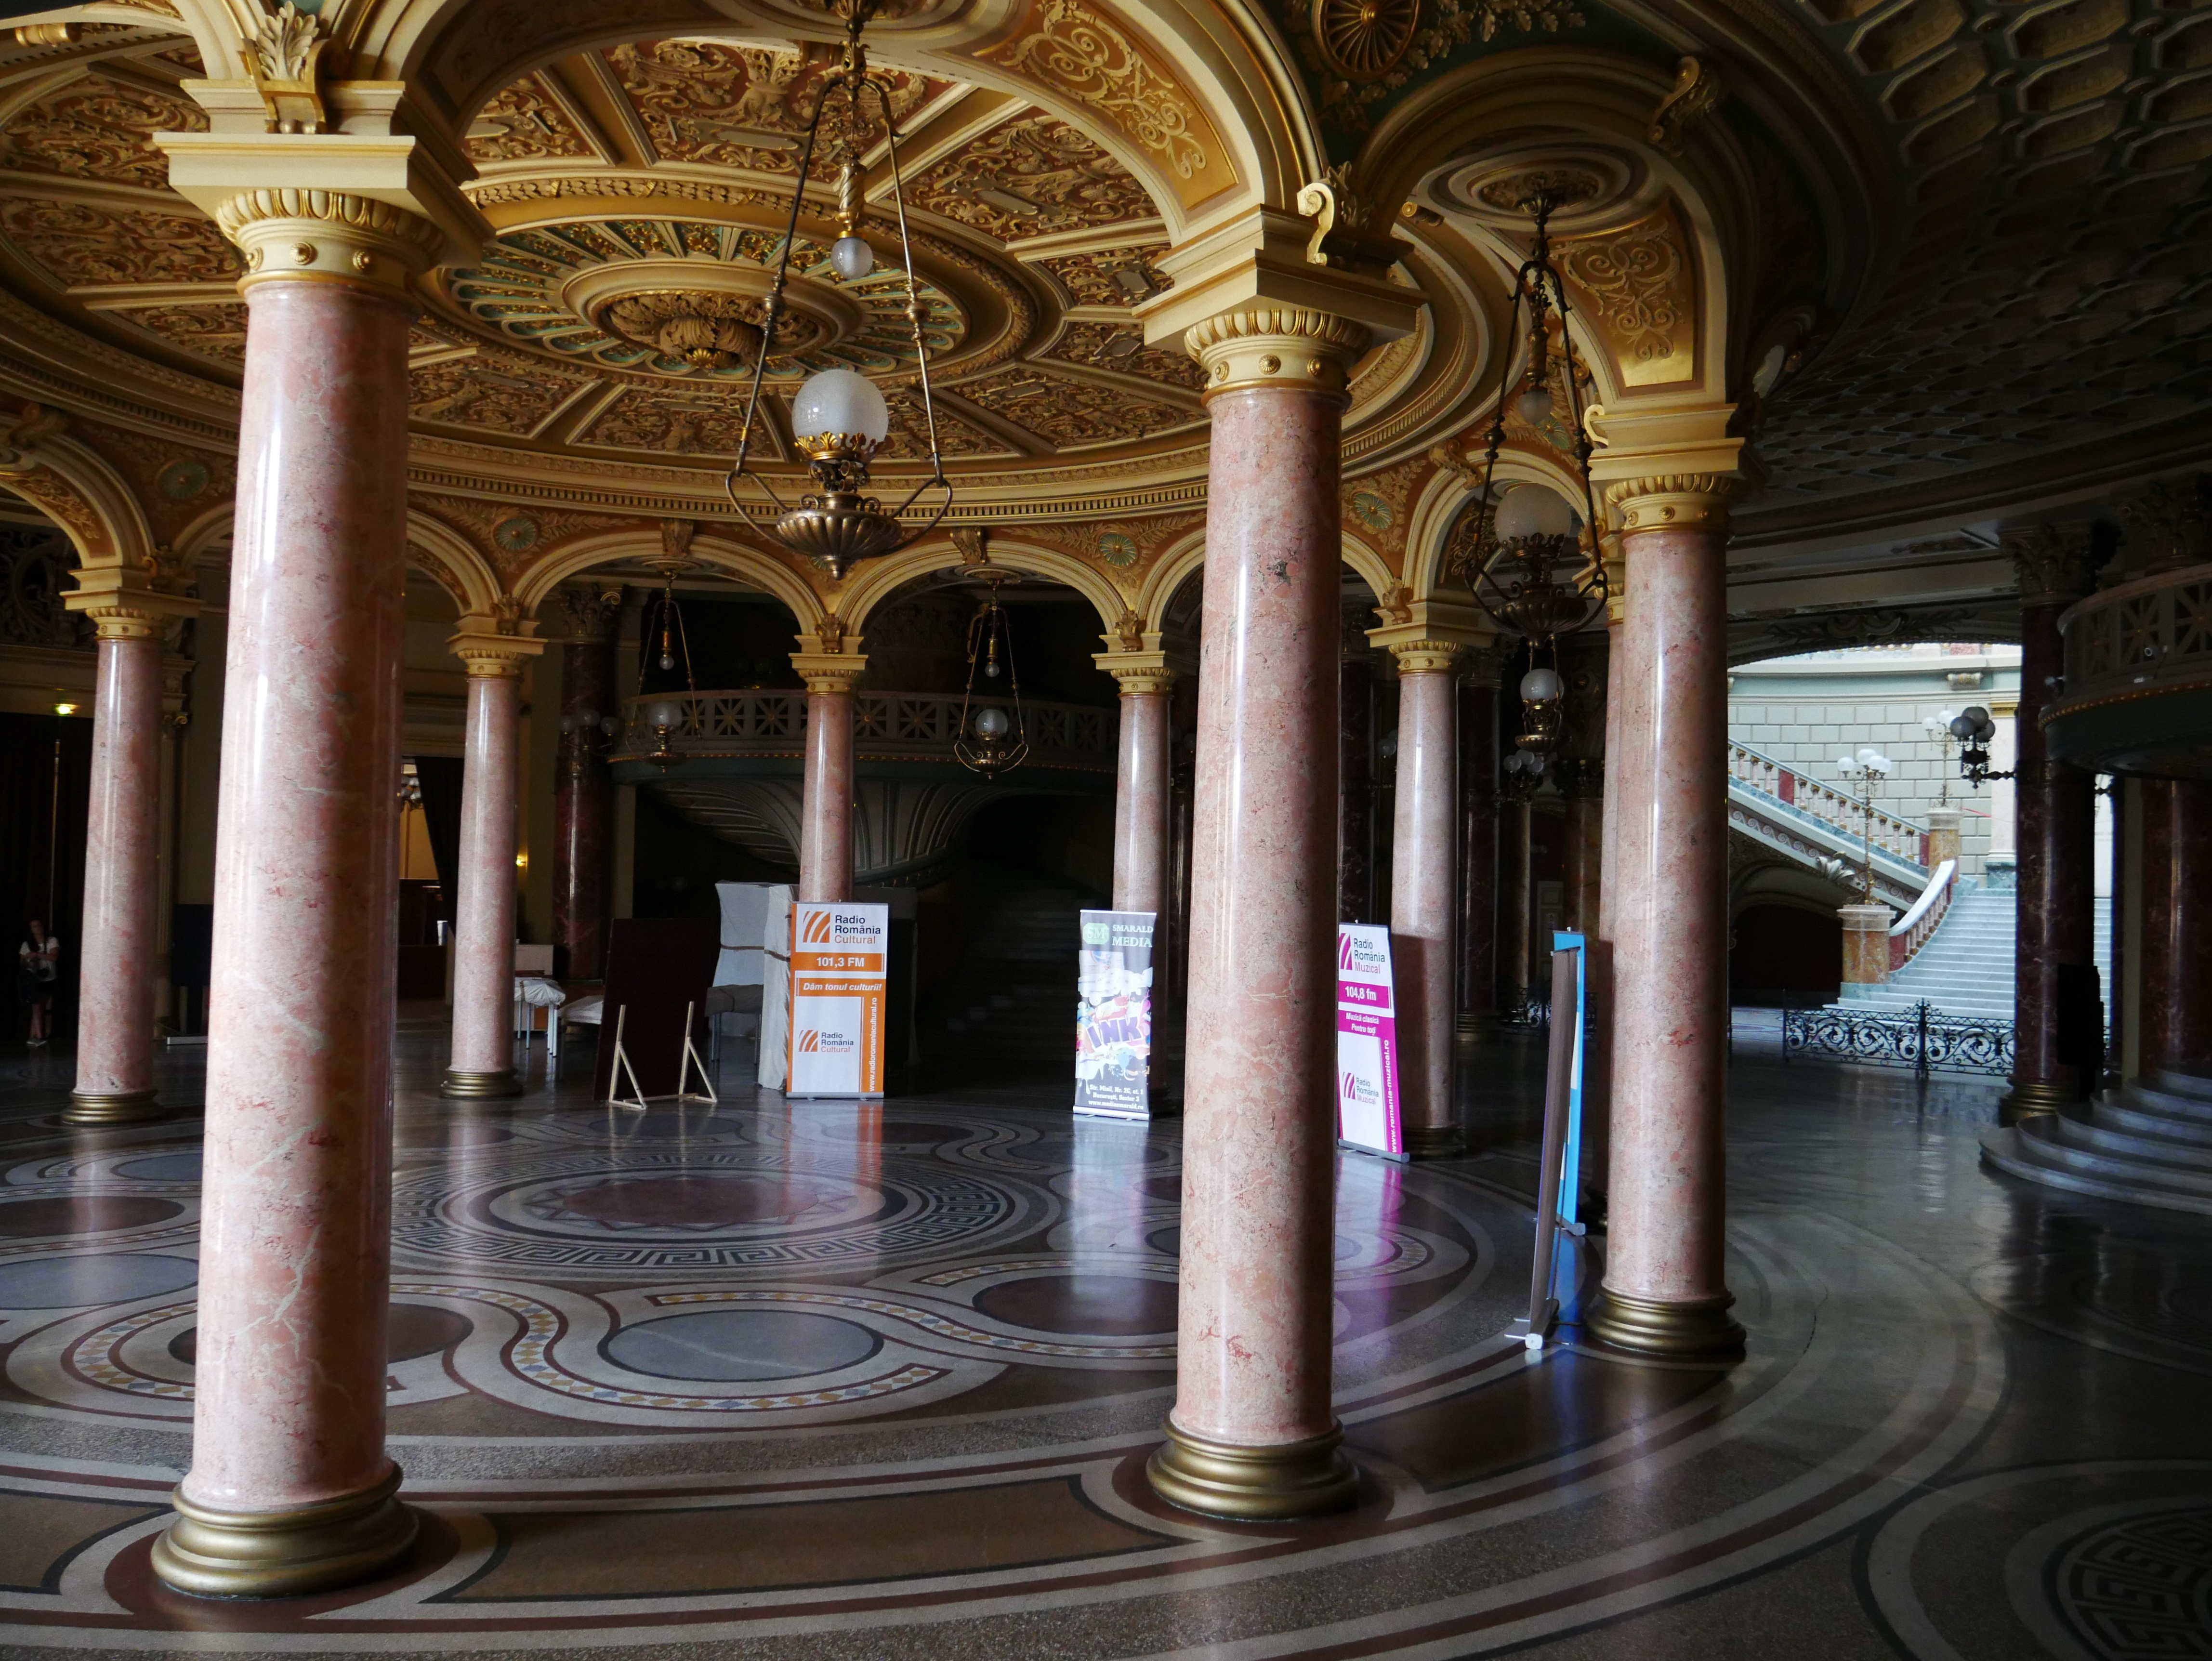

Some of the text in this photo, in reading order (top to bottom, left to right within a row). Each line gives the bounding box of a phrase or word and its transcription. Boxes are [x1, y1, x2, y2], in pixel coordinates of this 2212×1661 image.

[835, 915, 865, 924] Radio
[835, 925, 881, 934] România
[1087, 927, 1105, 939] SM
[1112, 924, 1154, 933] SMARALD
[834, 935, 875, 944] Cultural
[1112, 936, 1152, 948] MEDIA
[1354, 938, 1373, 949] Radio
[1354, 949, 1385, 962] România
[816, 957, 865, 968] 101,3 FM
[1355, 962, 1380, 974] Muzical
[803, 983, 823, 991] Dăm
[849, 983, 882, 991] culturii!
[1345, 986, 1377, 1001] 104,8 fm
[1346, 1012, 1379, 1024] Muzică clasică
[1087, 1016, 1142, 1049] INK
[1351, 1023, 1366, 1032] Pentru
[869, 997, 877, 1092] www.radioromaniacultural.ro
[1356, 1077, 1370, 1087] Radio
[1356, 1085, 1379, 1097] România
[1384, 1040, 1397, 1153] www.romania-muzical.ro
[1357, 1094, 1376, 1105] Muzical
